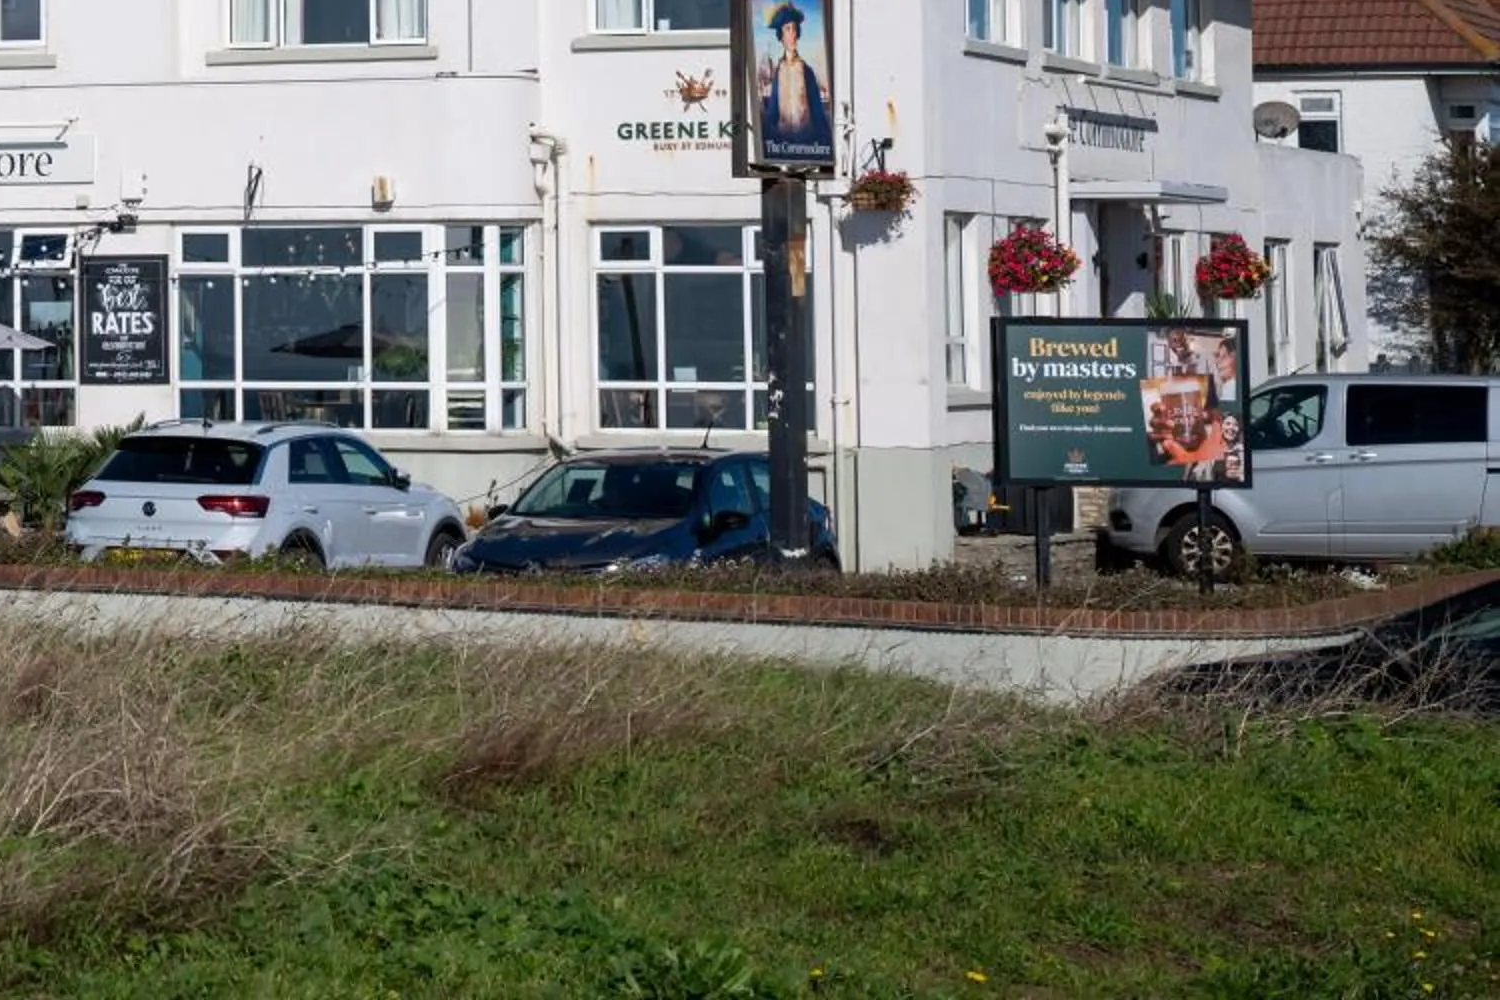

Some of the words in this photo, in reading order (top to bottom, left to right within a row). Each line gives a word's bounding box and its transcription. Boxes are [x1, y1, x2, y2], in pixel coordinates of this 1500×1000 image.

[617, 121, 709, 140] GREENE
[765, 140, 780, 153] The
[91, 311, 154, 335] RATES
[1029, 337, 1118, 357] Brewed
[1011, 357, 1039, 382] by
[1043, 360, 1137, 378] masters
